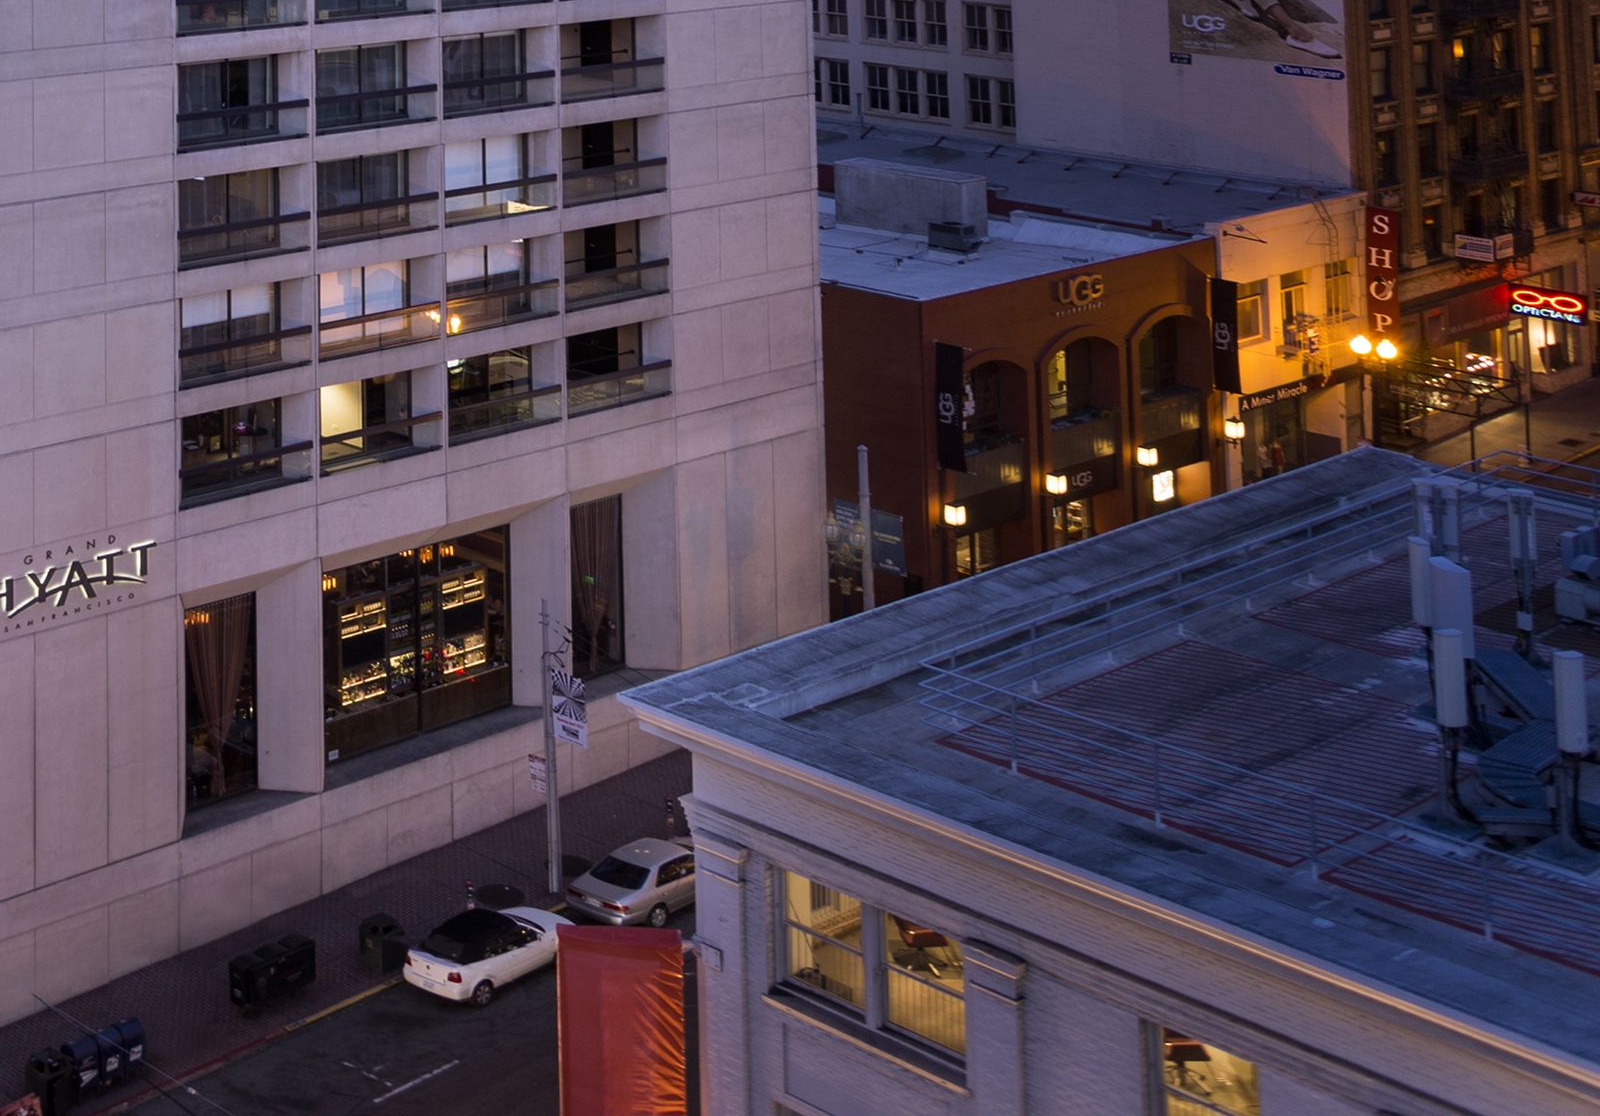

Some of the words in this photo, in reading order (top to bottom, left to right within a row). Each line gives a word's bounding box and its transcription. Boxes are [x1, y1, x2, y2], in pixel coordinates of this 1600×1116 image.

[1182, 14, 1227, 32] UGG
[1281, 64, 1301, 75] Van
[1302, 66, 1341, 79] Wagner
[1368, 214, 1394, 333] SHOP
[1058, 274, 1104, 306] UGG
[1511, 303, 1581, 324] OPTICIANS
[1215, 322, 1230, 350] UGG
[938, 392, 955, 425] UGG
[1071, 471, 1093, 487] UGG
[23, 534, 116, 565] GRAND
[4, 620, 34, 633] SAN
[41, 593, 135, 623] FRANCISCO
